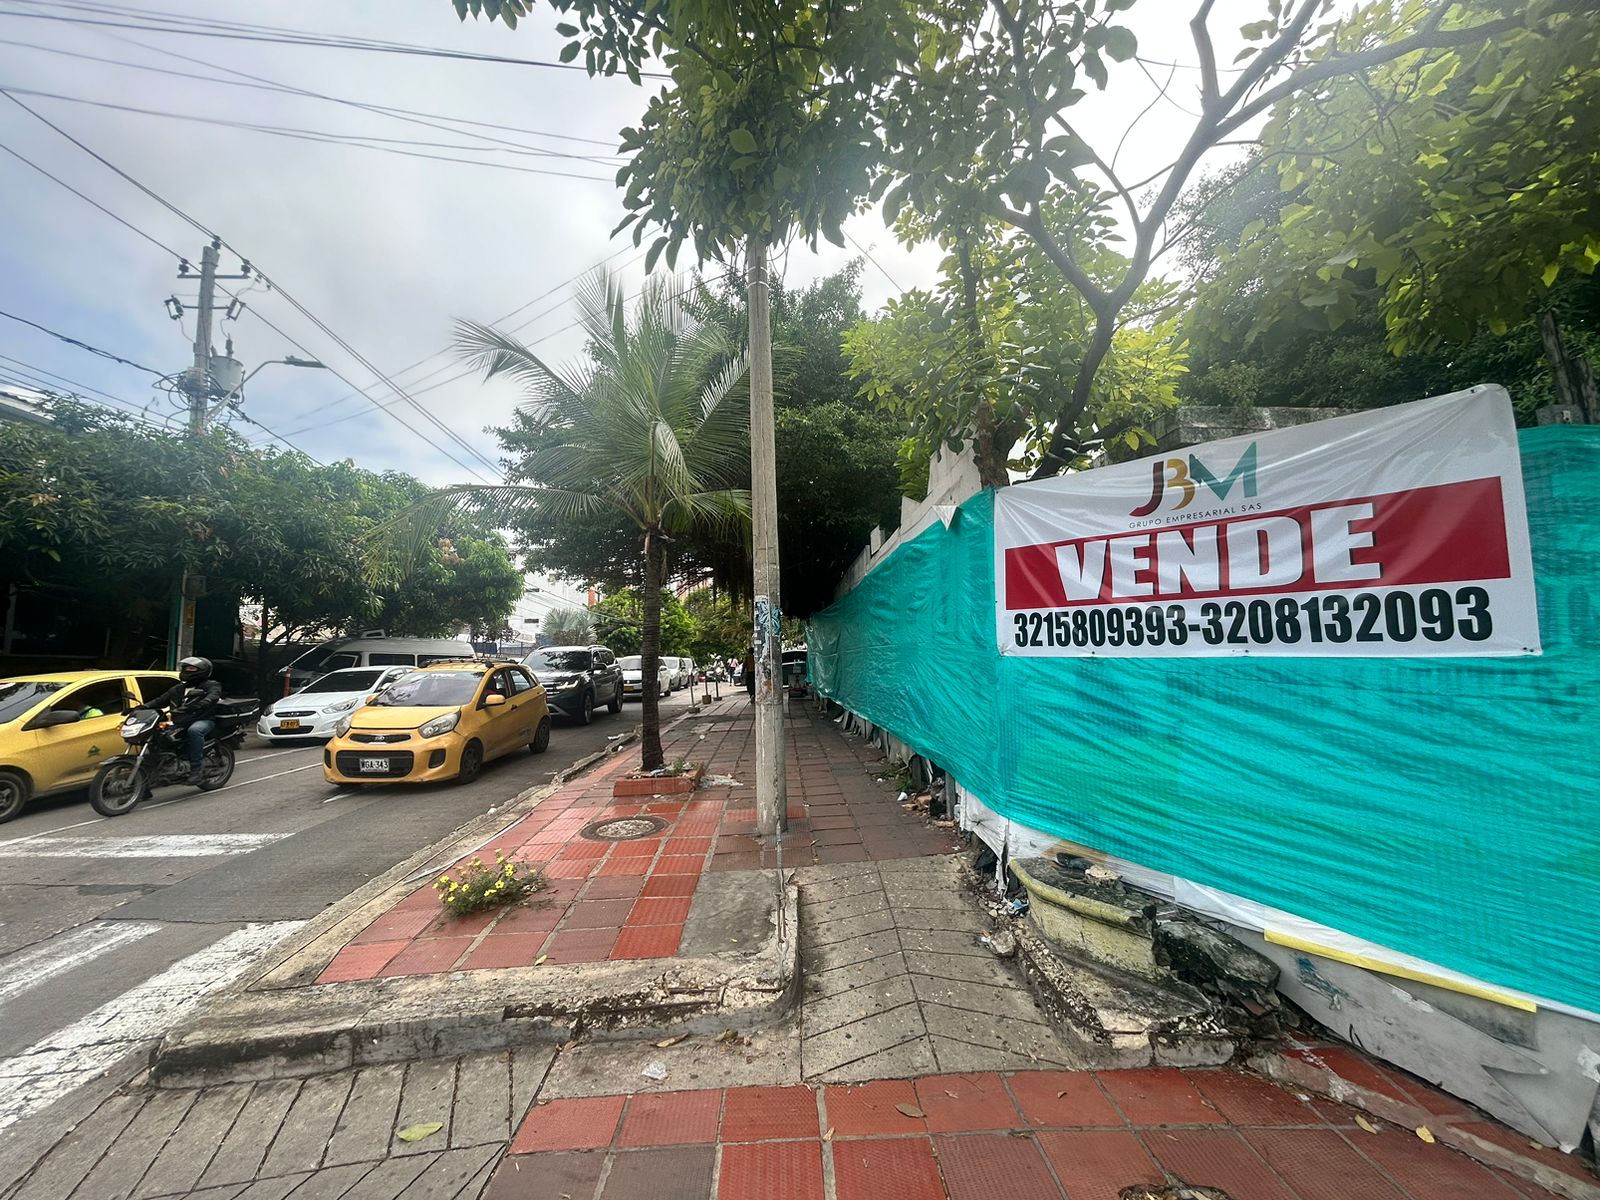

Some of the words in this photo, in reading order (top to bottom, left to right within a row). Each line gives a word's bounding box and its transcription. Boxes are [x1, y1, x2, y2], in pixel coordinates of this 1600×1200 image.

[1129, 441, 1257, 517] JBM
[1129, 518, 1162, 529] GRUPO
[1166, 507, 1236, 524] EMPRESARIAL
[1241, 502, 1263, 512] SAS
[1055, 503, 1382, 601] VENDE
[1013, 587, 1493, 647] 3215809393-3208132093
